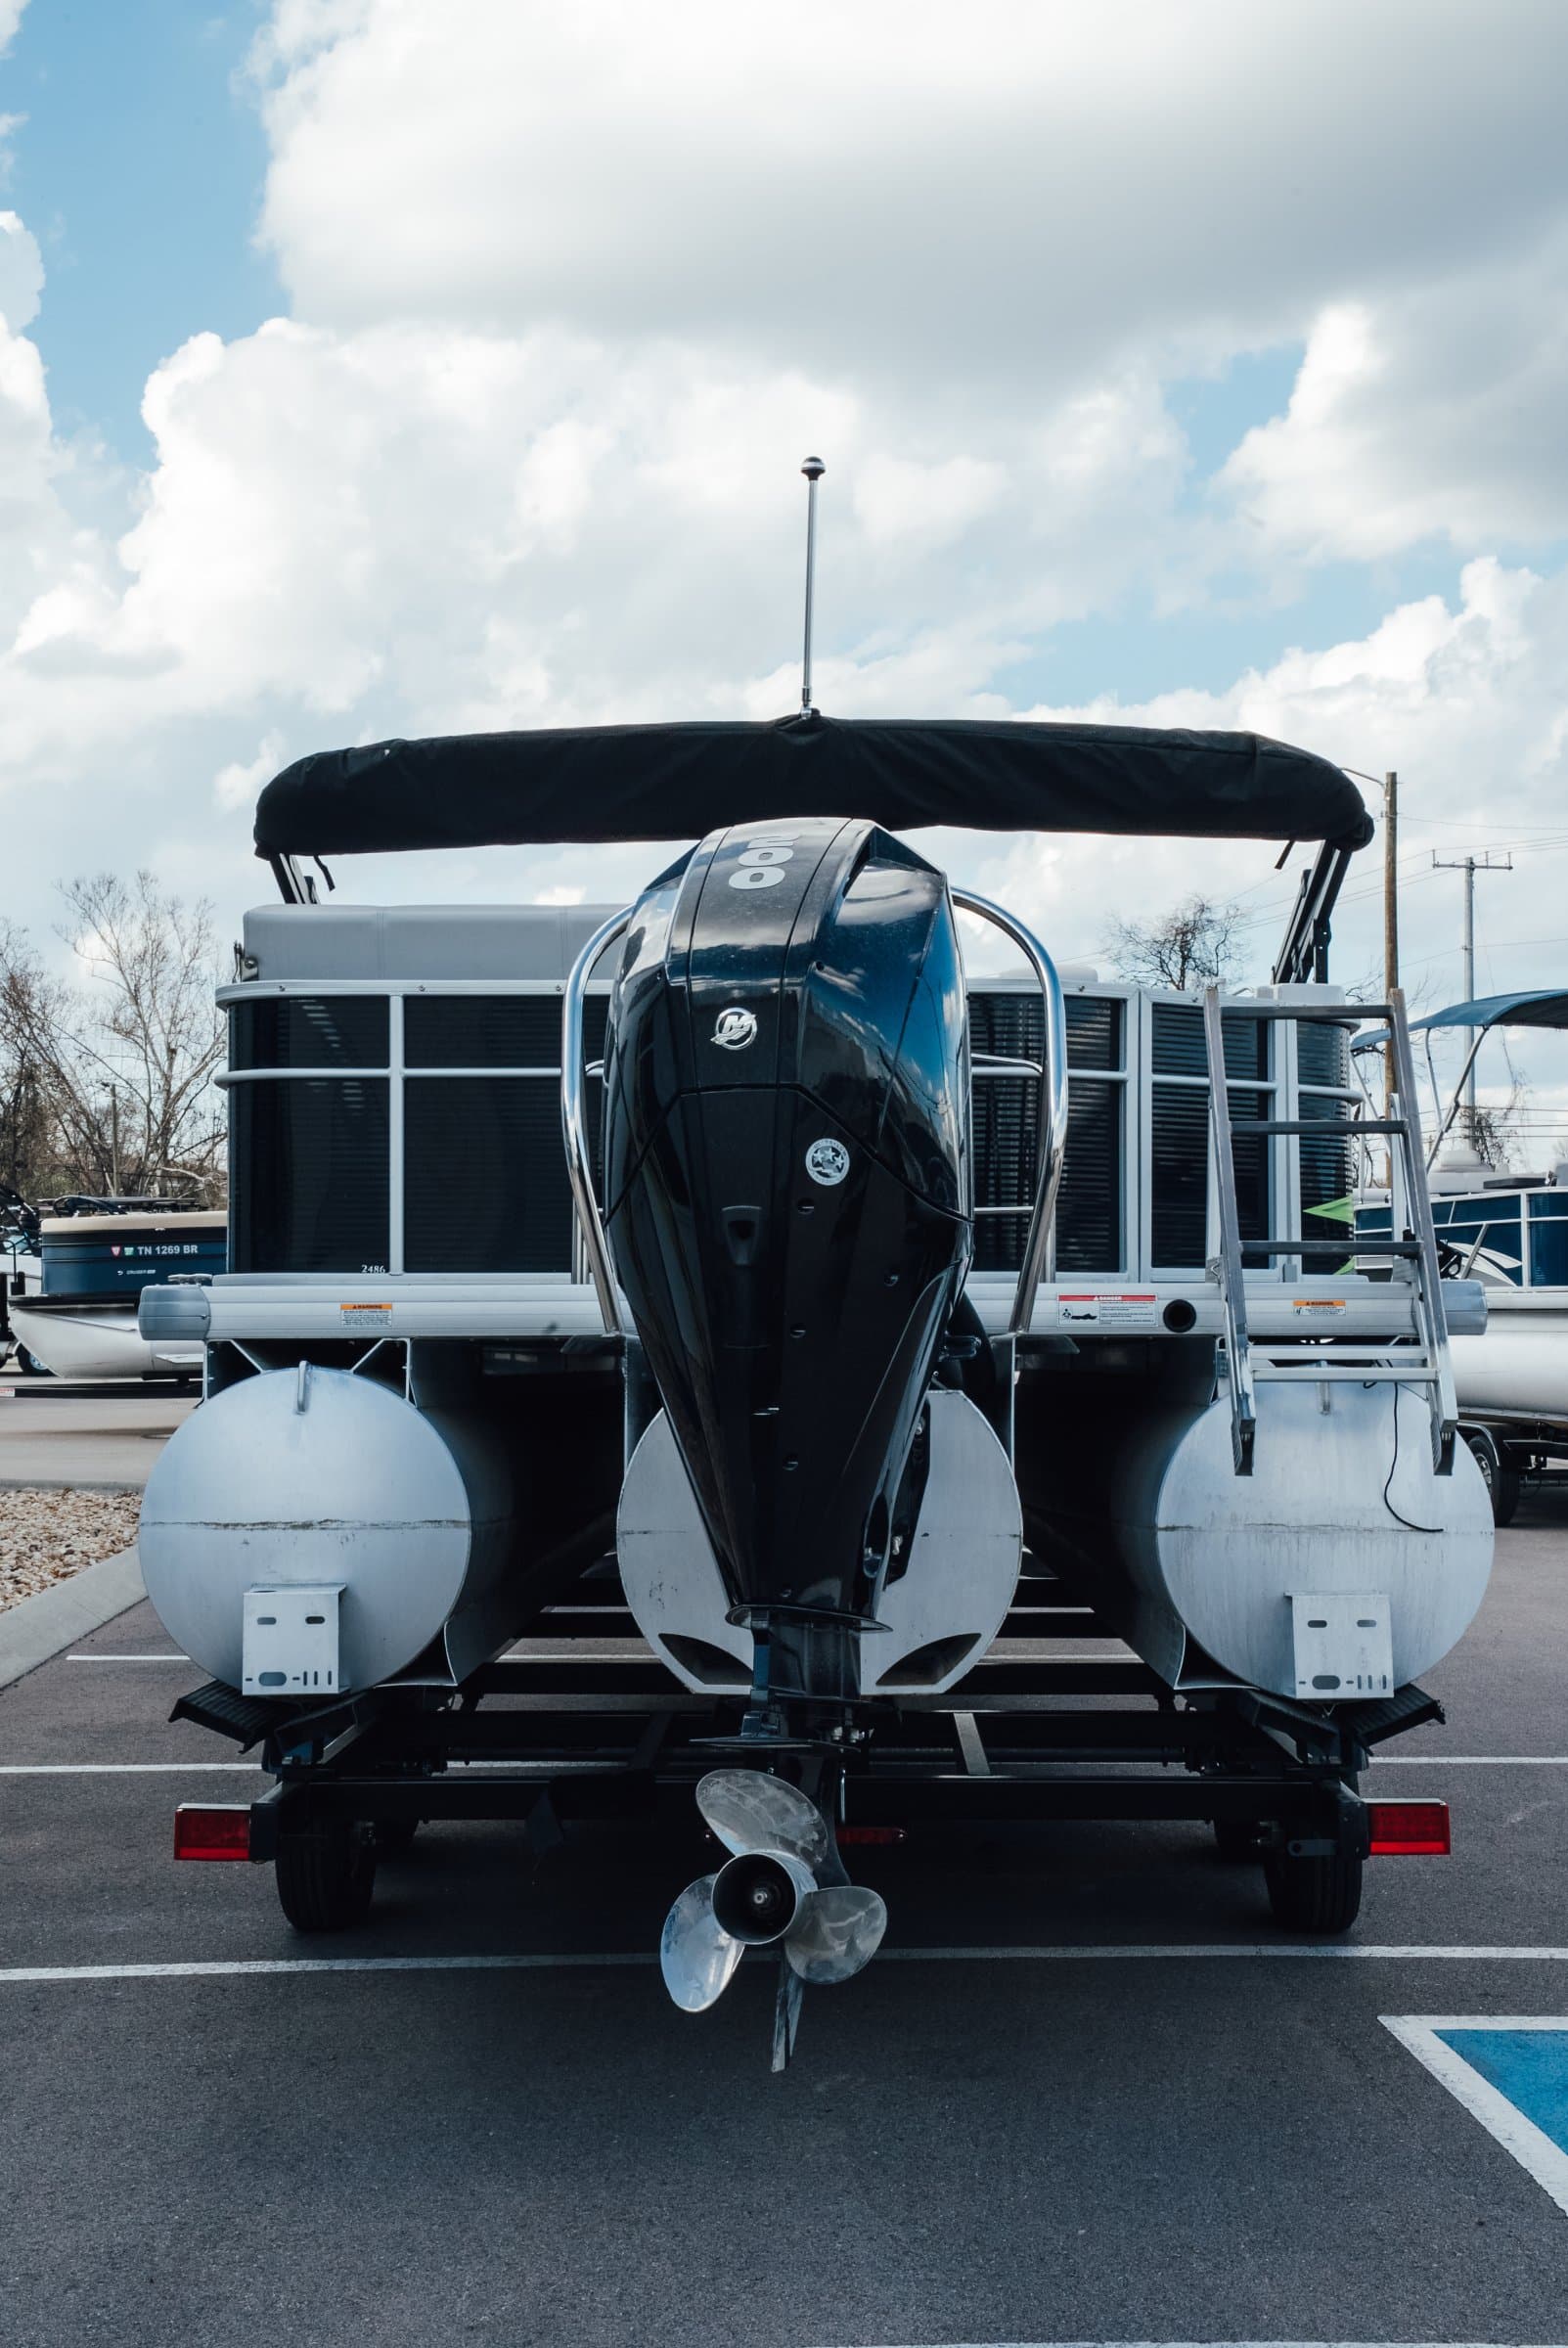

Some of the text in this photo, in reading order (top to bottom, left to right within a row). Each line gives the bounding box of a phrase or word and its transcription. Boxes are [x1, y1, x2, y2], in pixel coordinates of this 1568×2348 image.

[137, 1245, 152, 1255] TN
[155, 1244, 180, 1255] 1269
[183, 1244, 199, 1253] BR
[361, 1264, 385, 1274] 2486
